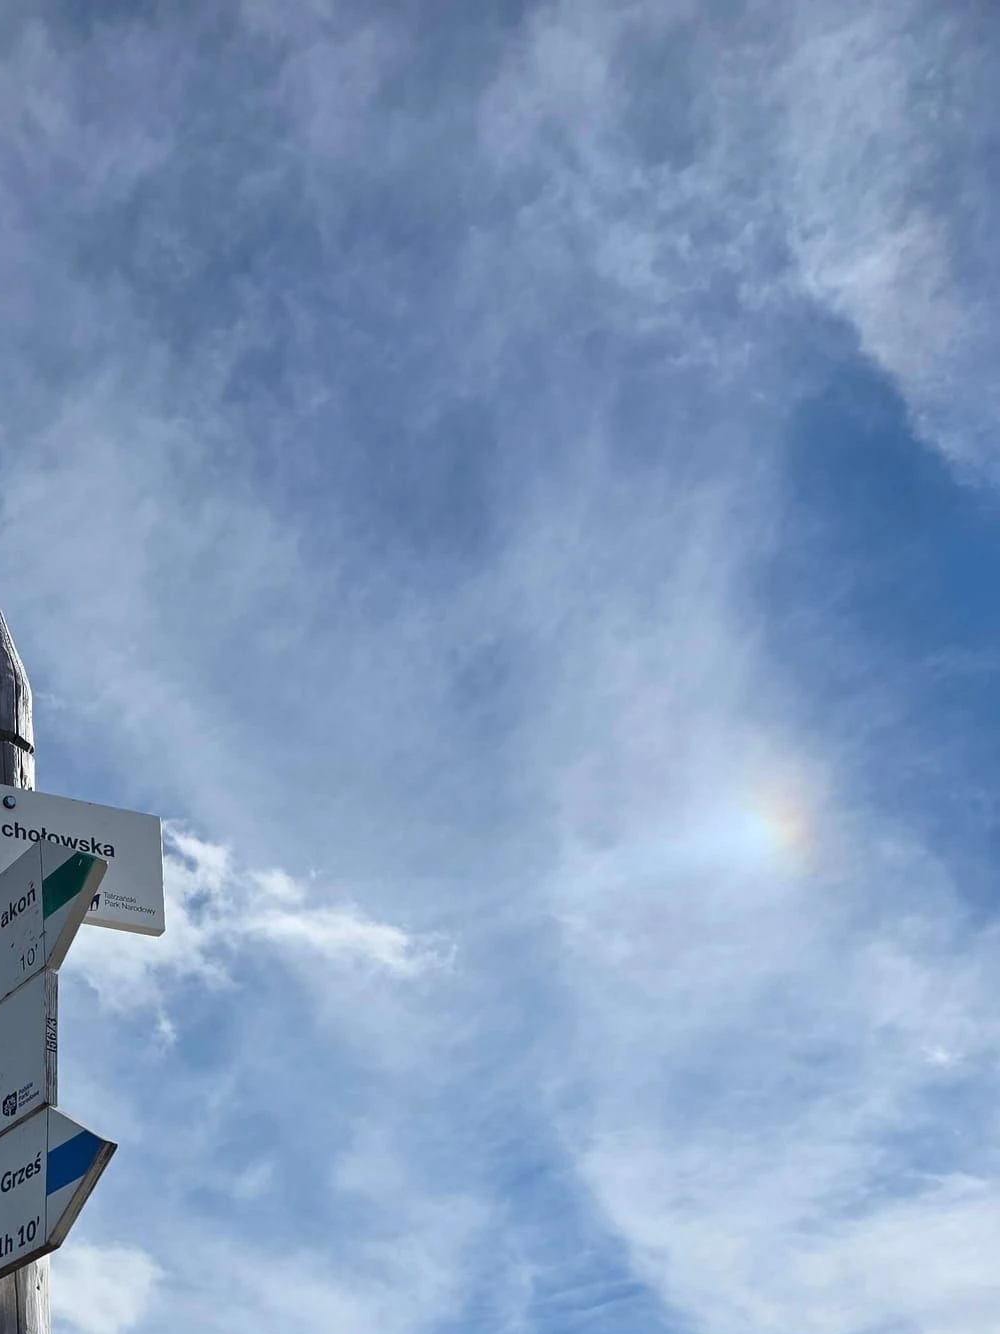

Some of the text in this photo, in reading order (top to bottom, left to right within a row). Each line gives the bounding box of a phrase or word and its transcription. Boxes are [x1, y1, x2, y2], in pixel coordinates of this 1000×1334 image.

[20, 943, 38, 971] 10'
[0, 1151, 42, 1193] Grześ
[17, 1215, 40, 1248] 10'
